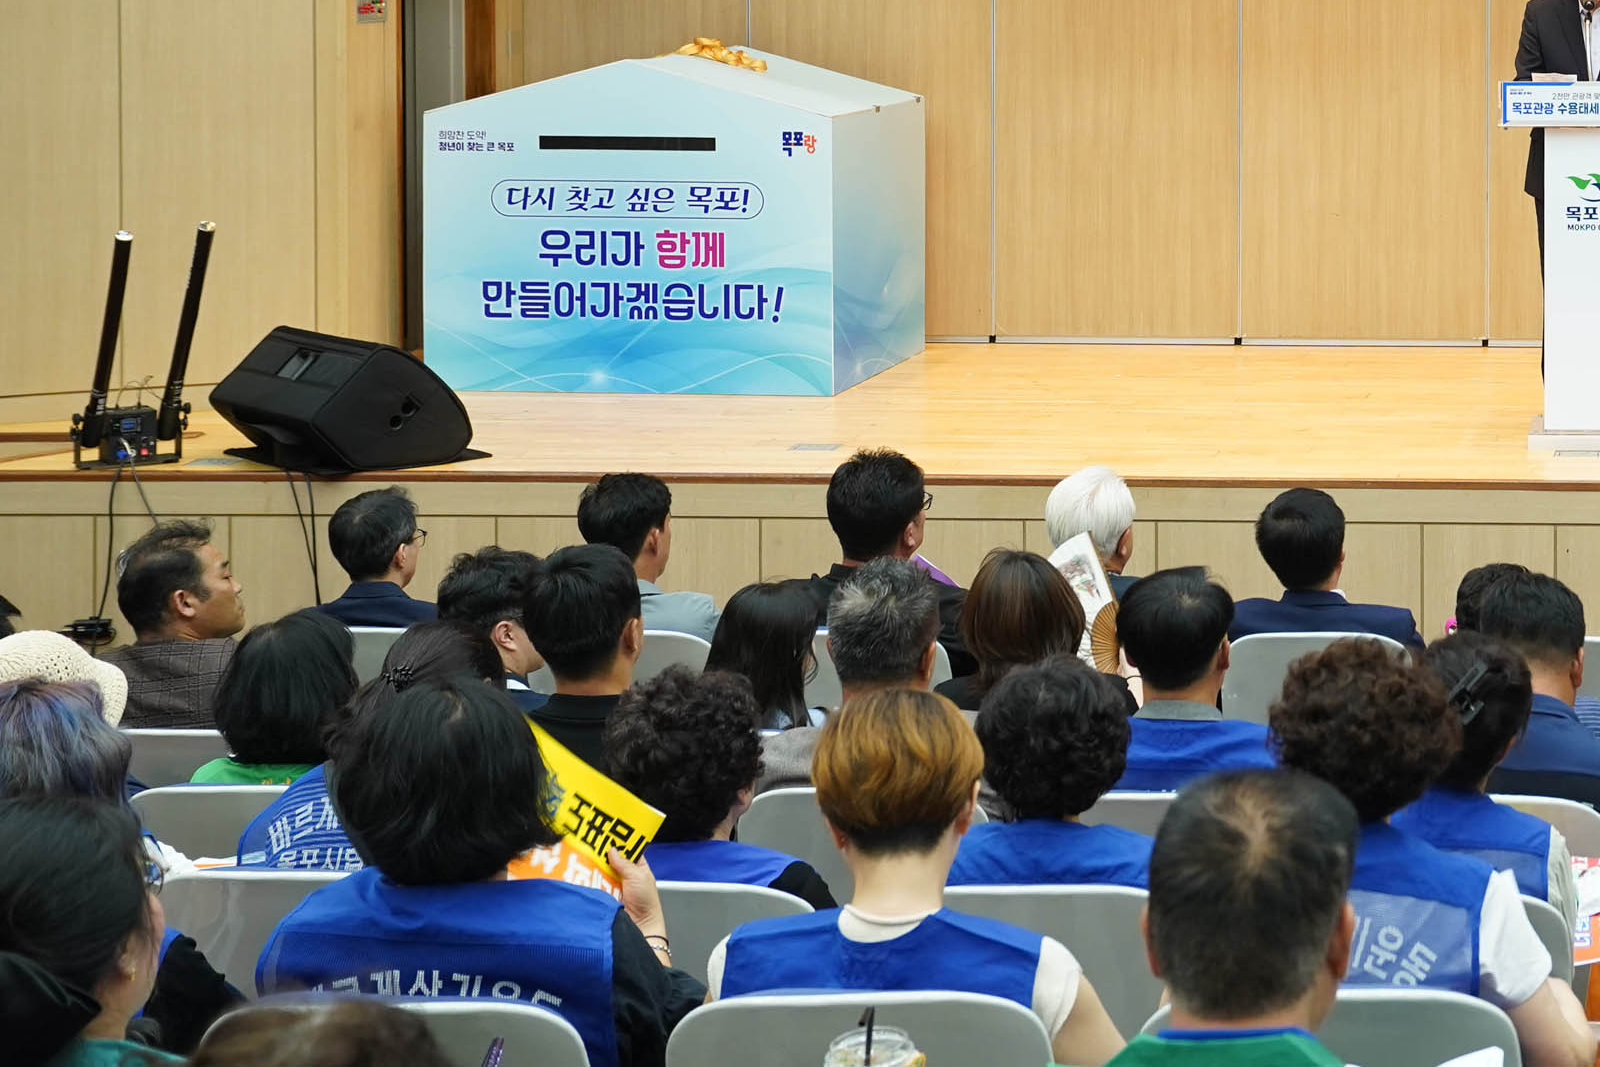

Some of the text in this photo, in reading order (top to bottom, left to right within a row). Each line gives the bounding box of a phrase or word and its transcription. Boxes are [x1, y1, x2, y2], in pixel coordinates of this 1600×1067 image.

[1512, 102, 1554, 115] 목포관광
[1557, 102, 1600, 115] 수용태세
[439, 130, 464, 140] 희망찬
[782, 131, 816, 157] 목포랑
[439, 141, 515, 152] 청년이 찾는 큰 목포
[506, 185, 750, 214] 다시 찾고 싶은 목포!
[1567, 223, 1597, 231] MOKPO
[538, 229, 725, 269] 우리가 함께
[482, 280, 784, 324] 만들어가겠습니다!
